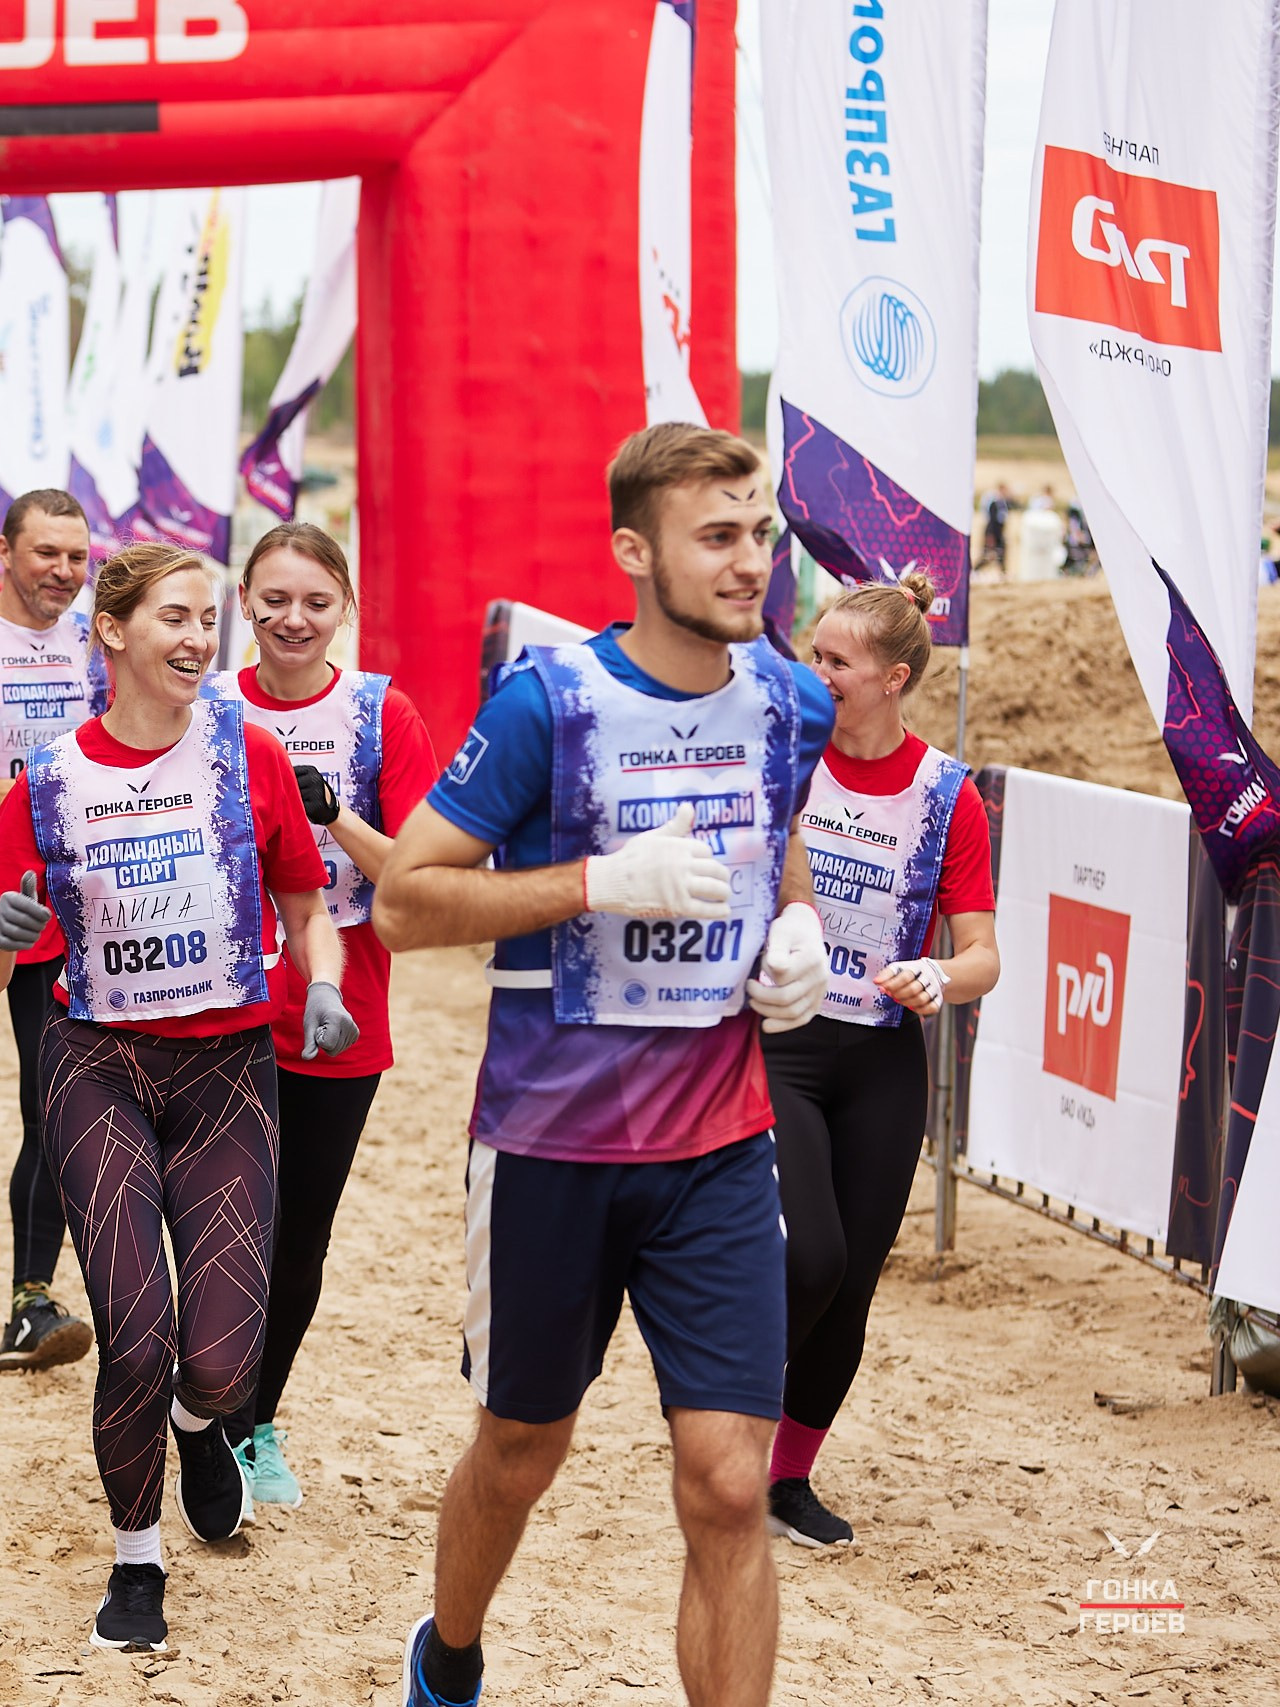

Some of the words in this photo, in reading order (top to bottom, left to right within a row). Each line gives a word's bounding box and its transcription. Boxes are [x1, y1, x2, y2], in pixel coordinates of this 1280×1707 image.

[1, 656, 36, 666] ГОНКА
[3, 682, 83, 702] КОМАНДНЫЙ
[26, 702, 63, 717] СТАРТ
[285, 740, 335, 751] ГЕРОЕВ
[620, 750, 677, 766] ГОНКА
[684, 745, 746, 762] ГЕРОЕВ
[85, 803, 134, 819] ГОНКА
[138, 793, 193, 812] ГЕРОЕВ
[621, 789, 753, 829] КОМДНЫЙ
[801, 813, 844, 834] ГОНКА
[847, 826, 898, 847] ГЕРОЕВ
[88, 828, 202, 868] КОМАНДНЫЙ
[119, 861, 171, 886] СТАРТ
[807, 849, 894, 889] МАНДНЫЙ
[813, 875, 861, 901] СТАРТ
[101, 892, 199, 929] АЛИНА
[103, 930, 208, 976] 03208
[624, 919, 744, 962] 03207
[133, 980, 213, 1004] ГАЗПРОМБАНК
